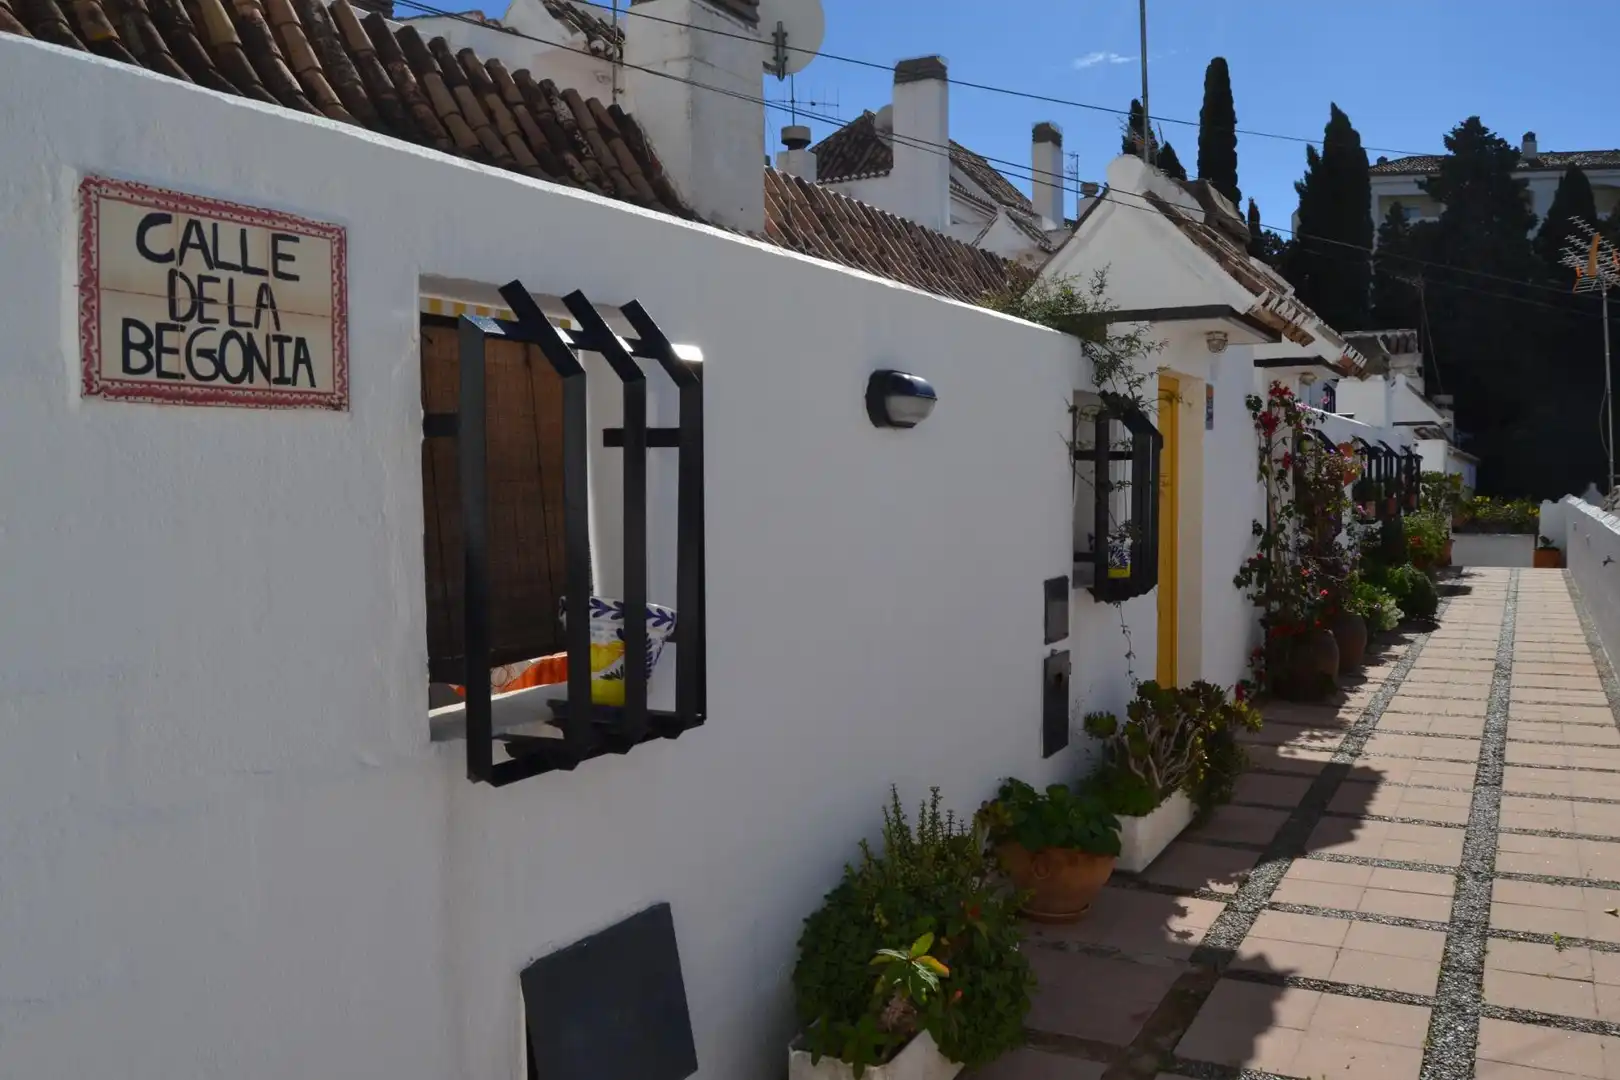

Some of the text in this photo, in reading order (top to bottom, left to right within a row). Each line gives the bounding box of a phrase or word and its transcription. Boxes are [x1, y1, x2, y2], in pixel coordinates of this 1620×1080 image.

[136, 212, 300, 281] CALLE
[168, 268, 281, 331] DE LA
[122, 317, 316, 388] BEGONIA
